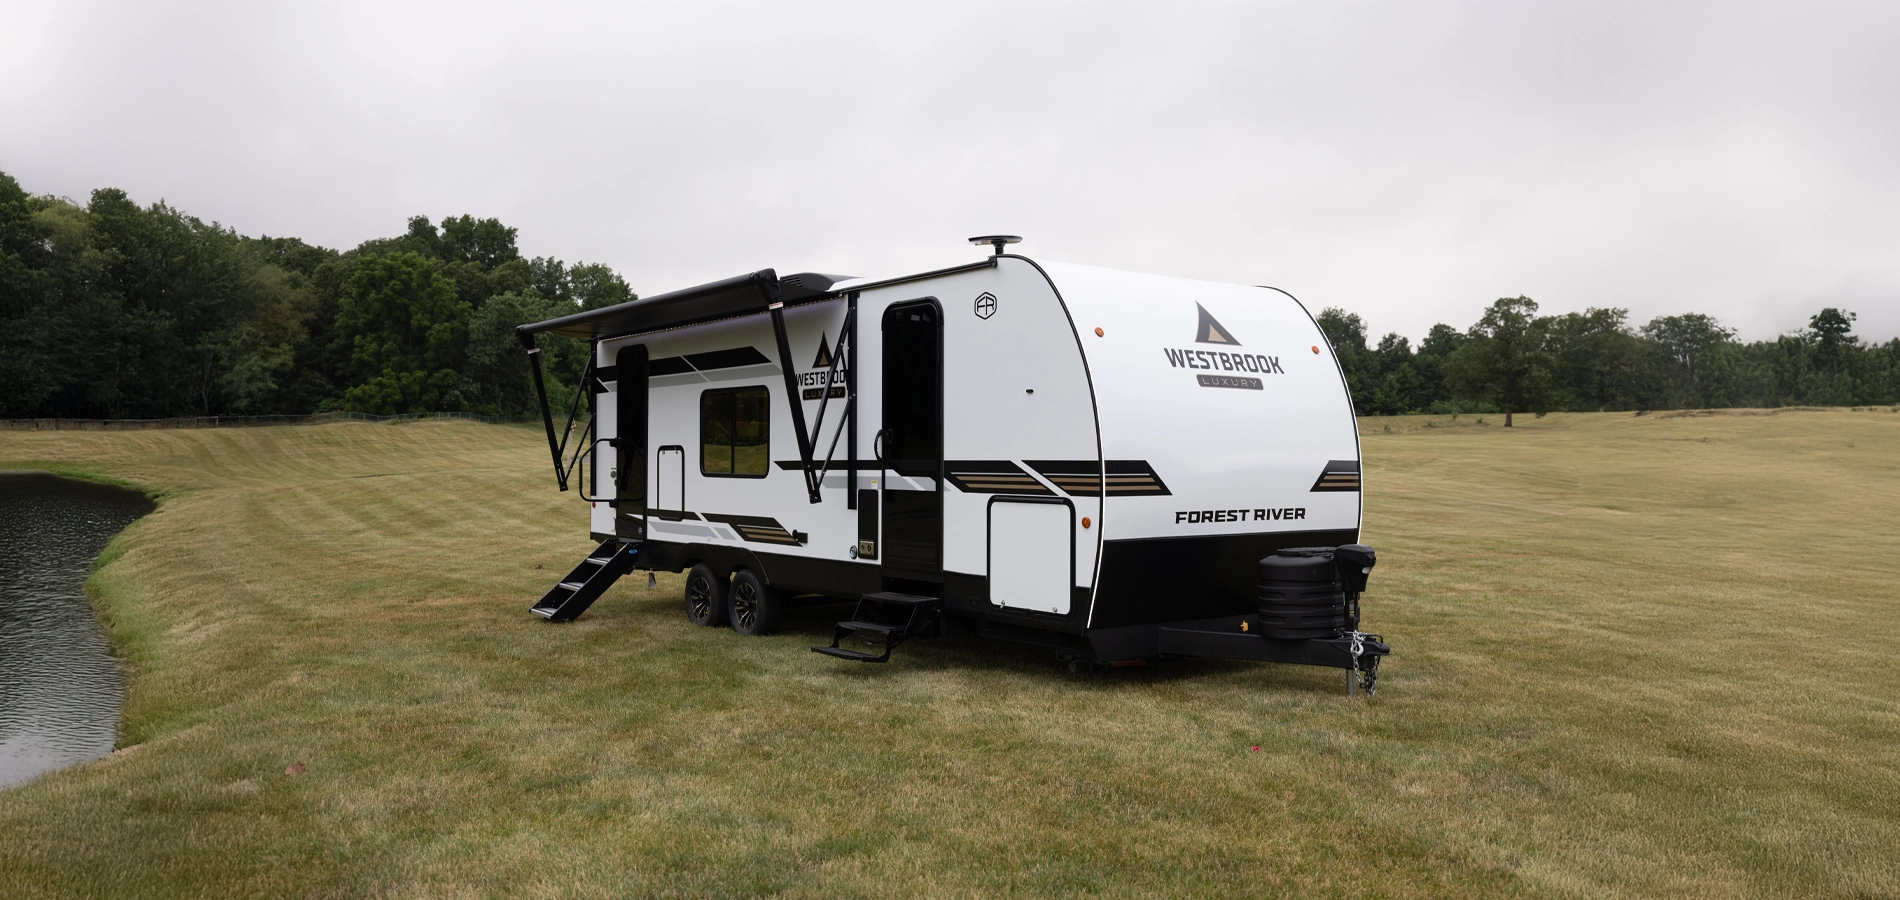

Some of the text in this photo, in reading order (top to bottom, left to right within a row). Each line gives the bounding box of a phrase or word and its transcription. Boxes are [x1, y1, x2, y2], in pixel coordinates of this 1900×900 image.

[1163, 348, 1285, 375] WESTBROOK
[795, 369, 849, 387] WESTBOO
[1201, 377, 1258, 388] LUXURY
[805, 388, 843, 399] LUXRY
[1175, 507, 1306, 524] FOREST RIVER
